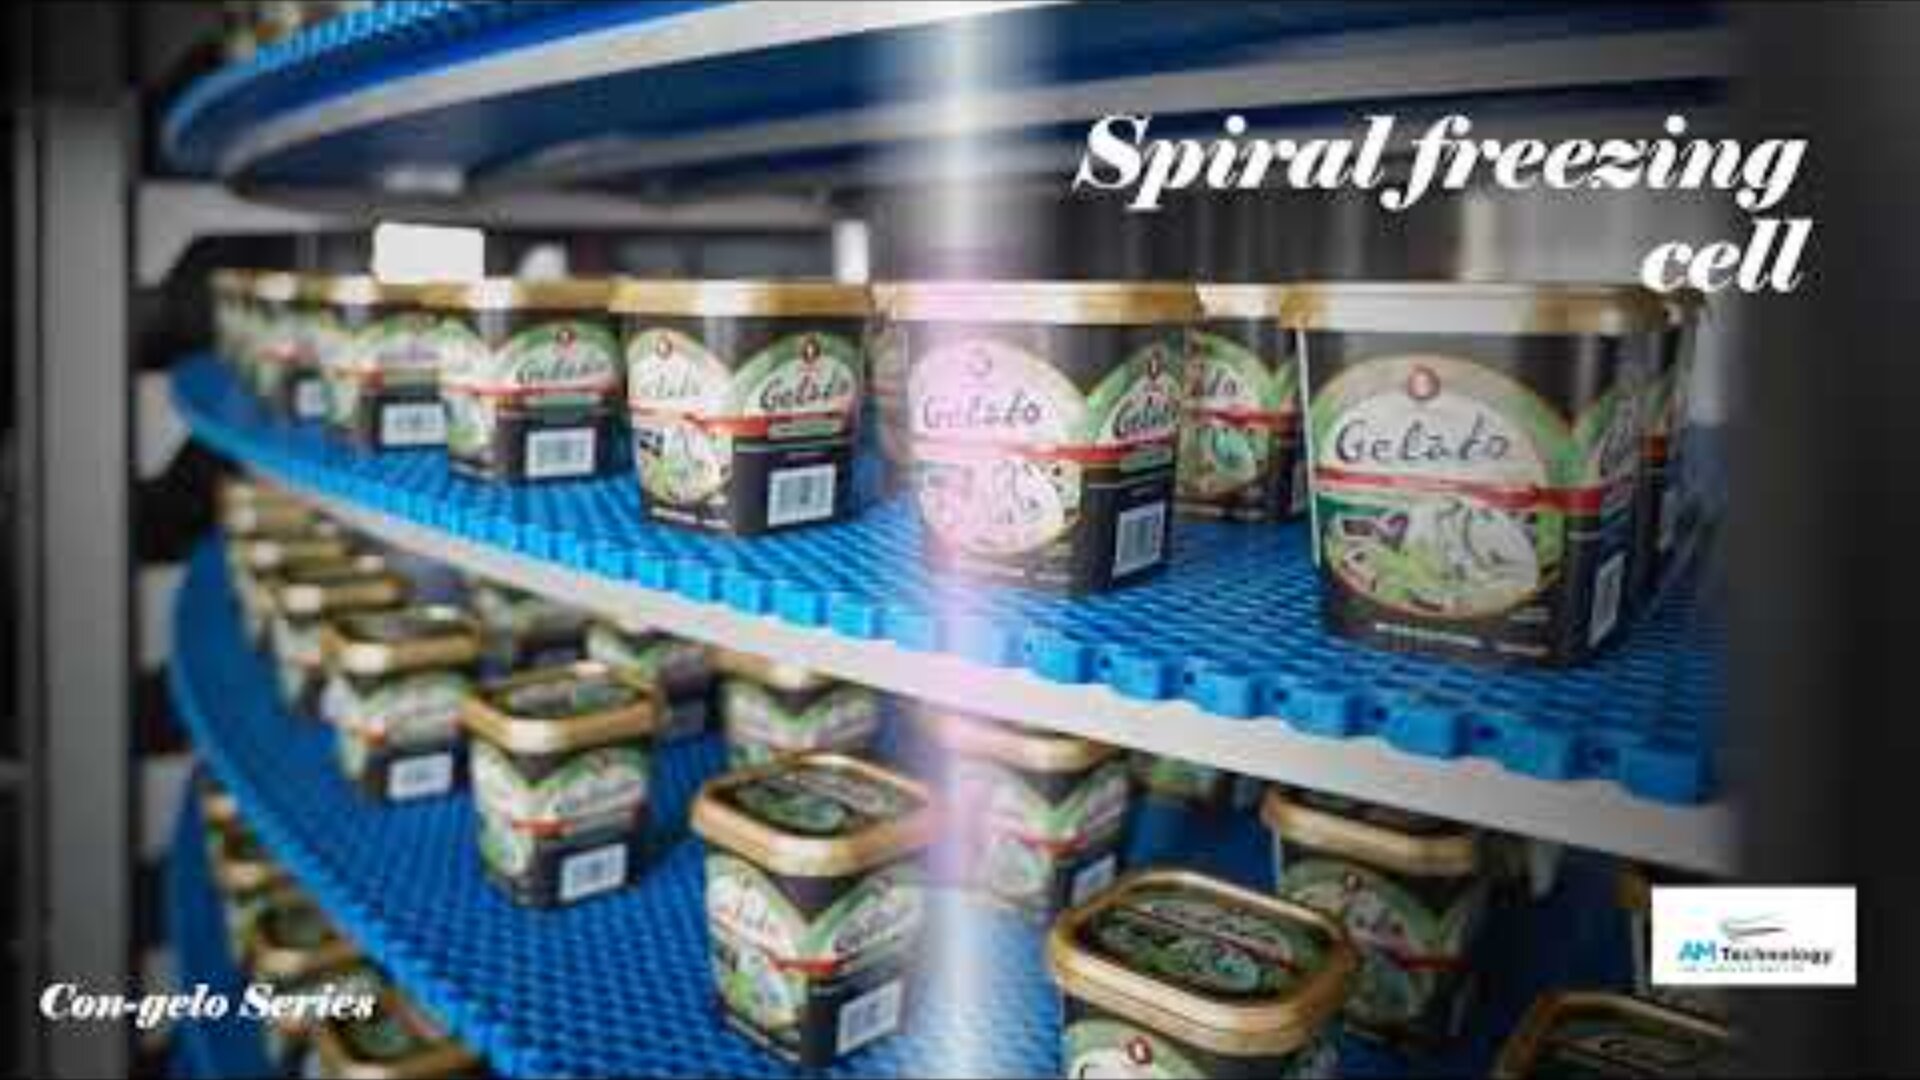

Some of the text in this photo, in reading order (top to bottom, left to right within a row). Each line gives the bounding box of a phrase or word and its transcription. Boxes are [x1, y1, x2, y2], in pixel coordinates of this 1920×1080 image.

[760, 370, 850, 411] Gelato
[924, 389, 1041, 429] Gelato
[1336, 411, 1512, 463] Gelato
